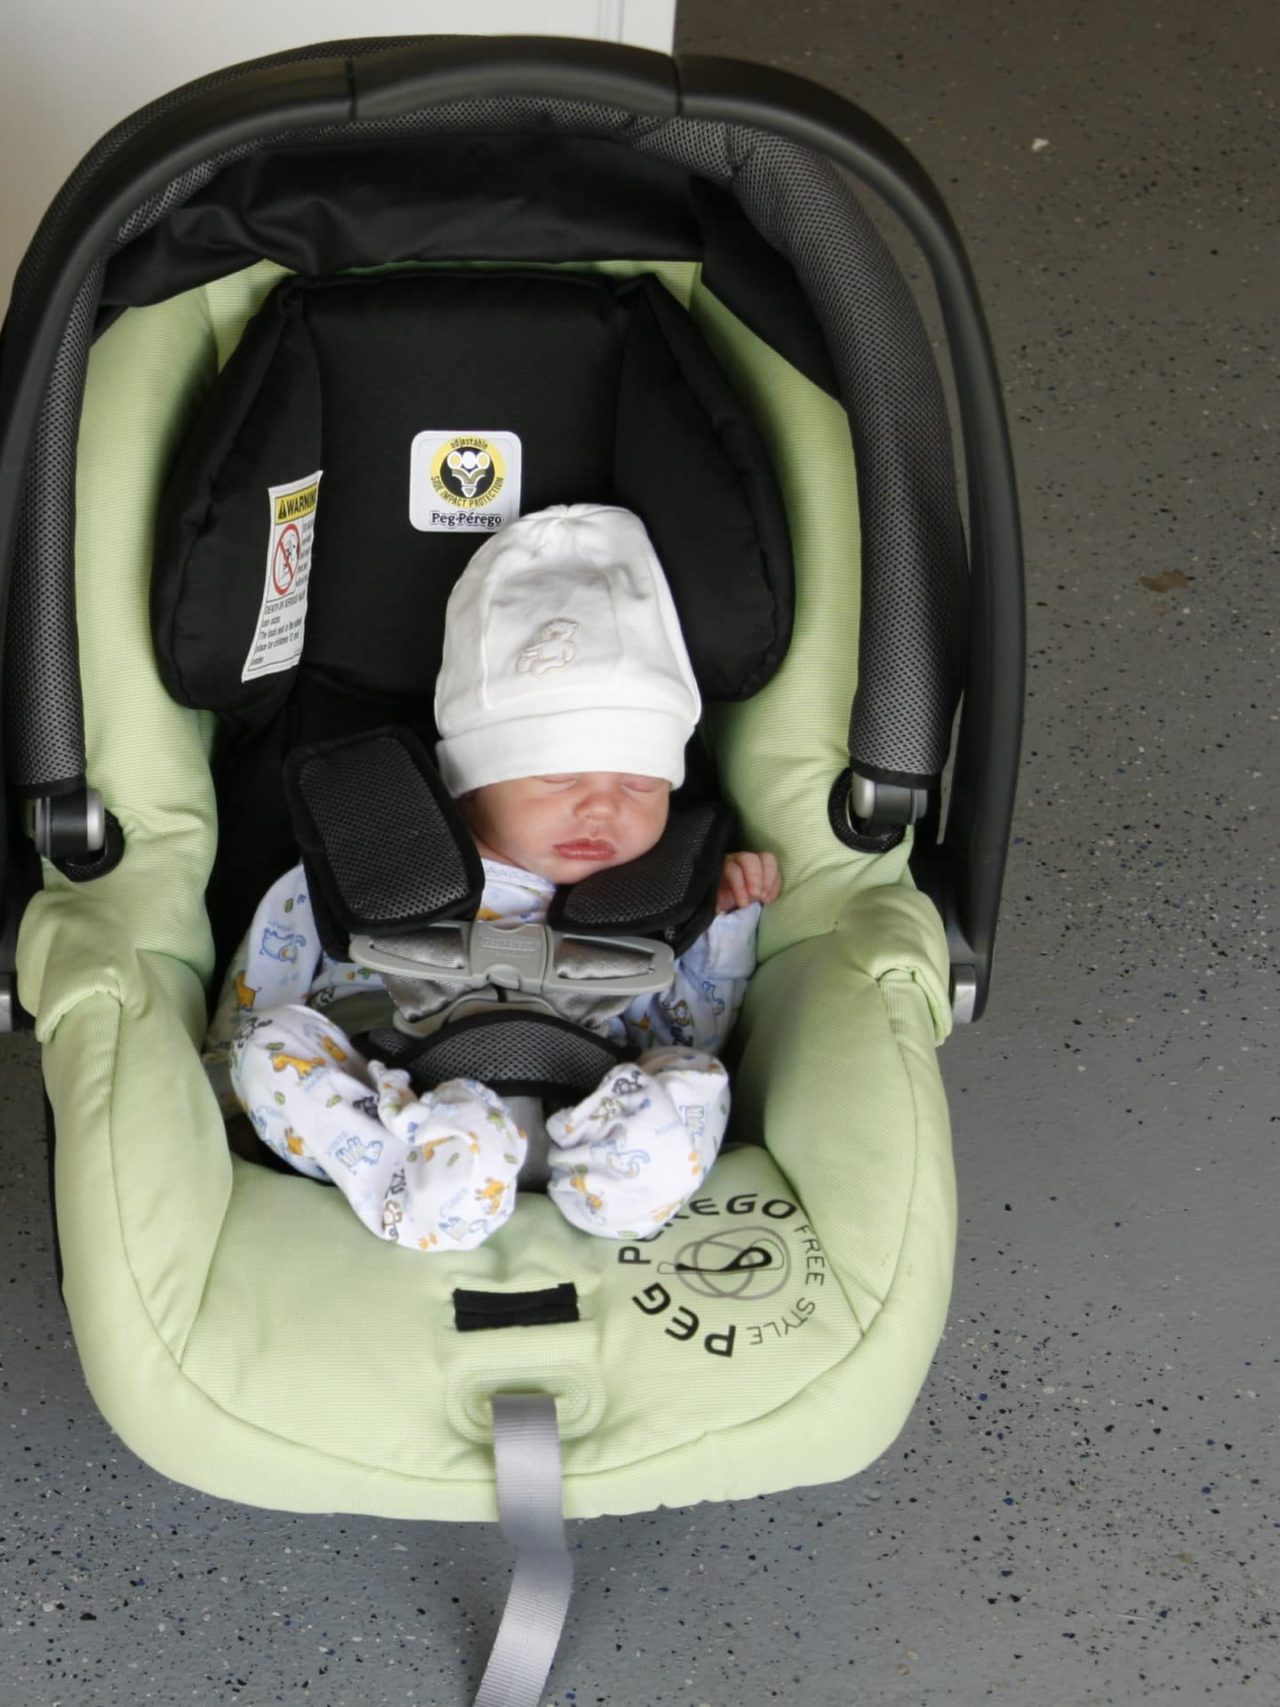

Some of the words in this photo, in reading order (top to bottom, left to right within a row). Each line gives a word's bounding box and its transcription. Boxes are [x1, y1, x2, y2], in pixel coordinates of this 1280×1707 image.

[450, 438, 488, 450] adjustable
[431, 475, 441, 492] SIDE
[440, 490, 466, 507] IMPACT
[469, 476, 504, 508] PROTECTION
[617, 1193, 797, 1265] PEGO
[794, 1224, 825, 1287] FREE
[631, 1282, 736, 1358] PEG
[746, 1297, 816, 1345] STYLE
